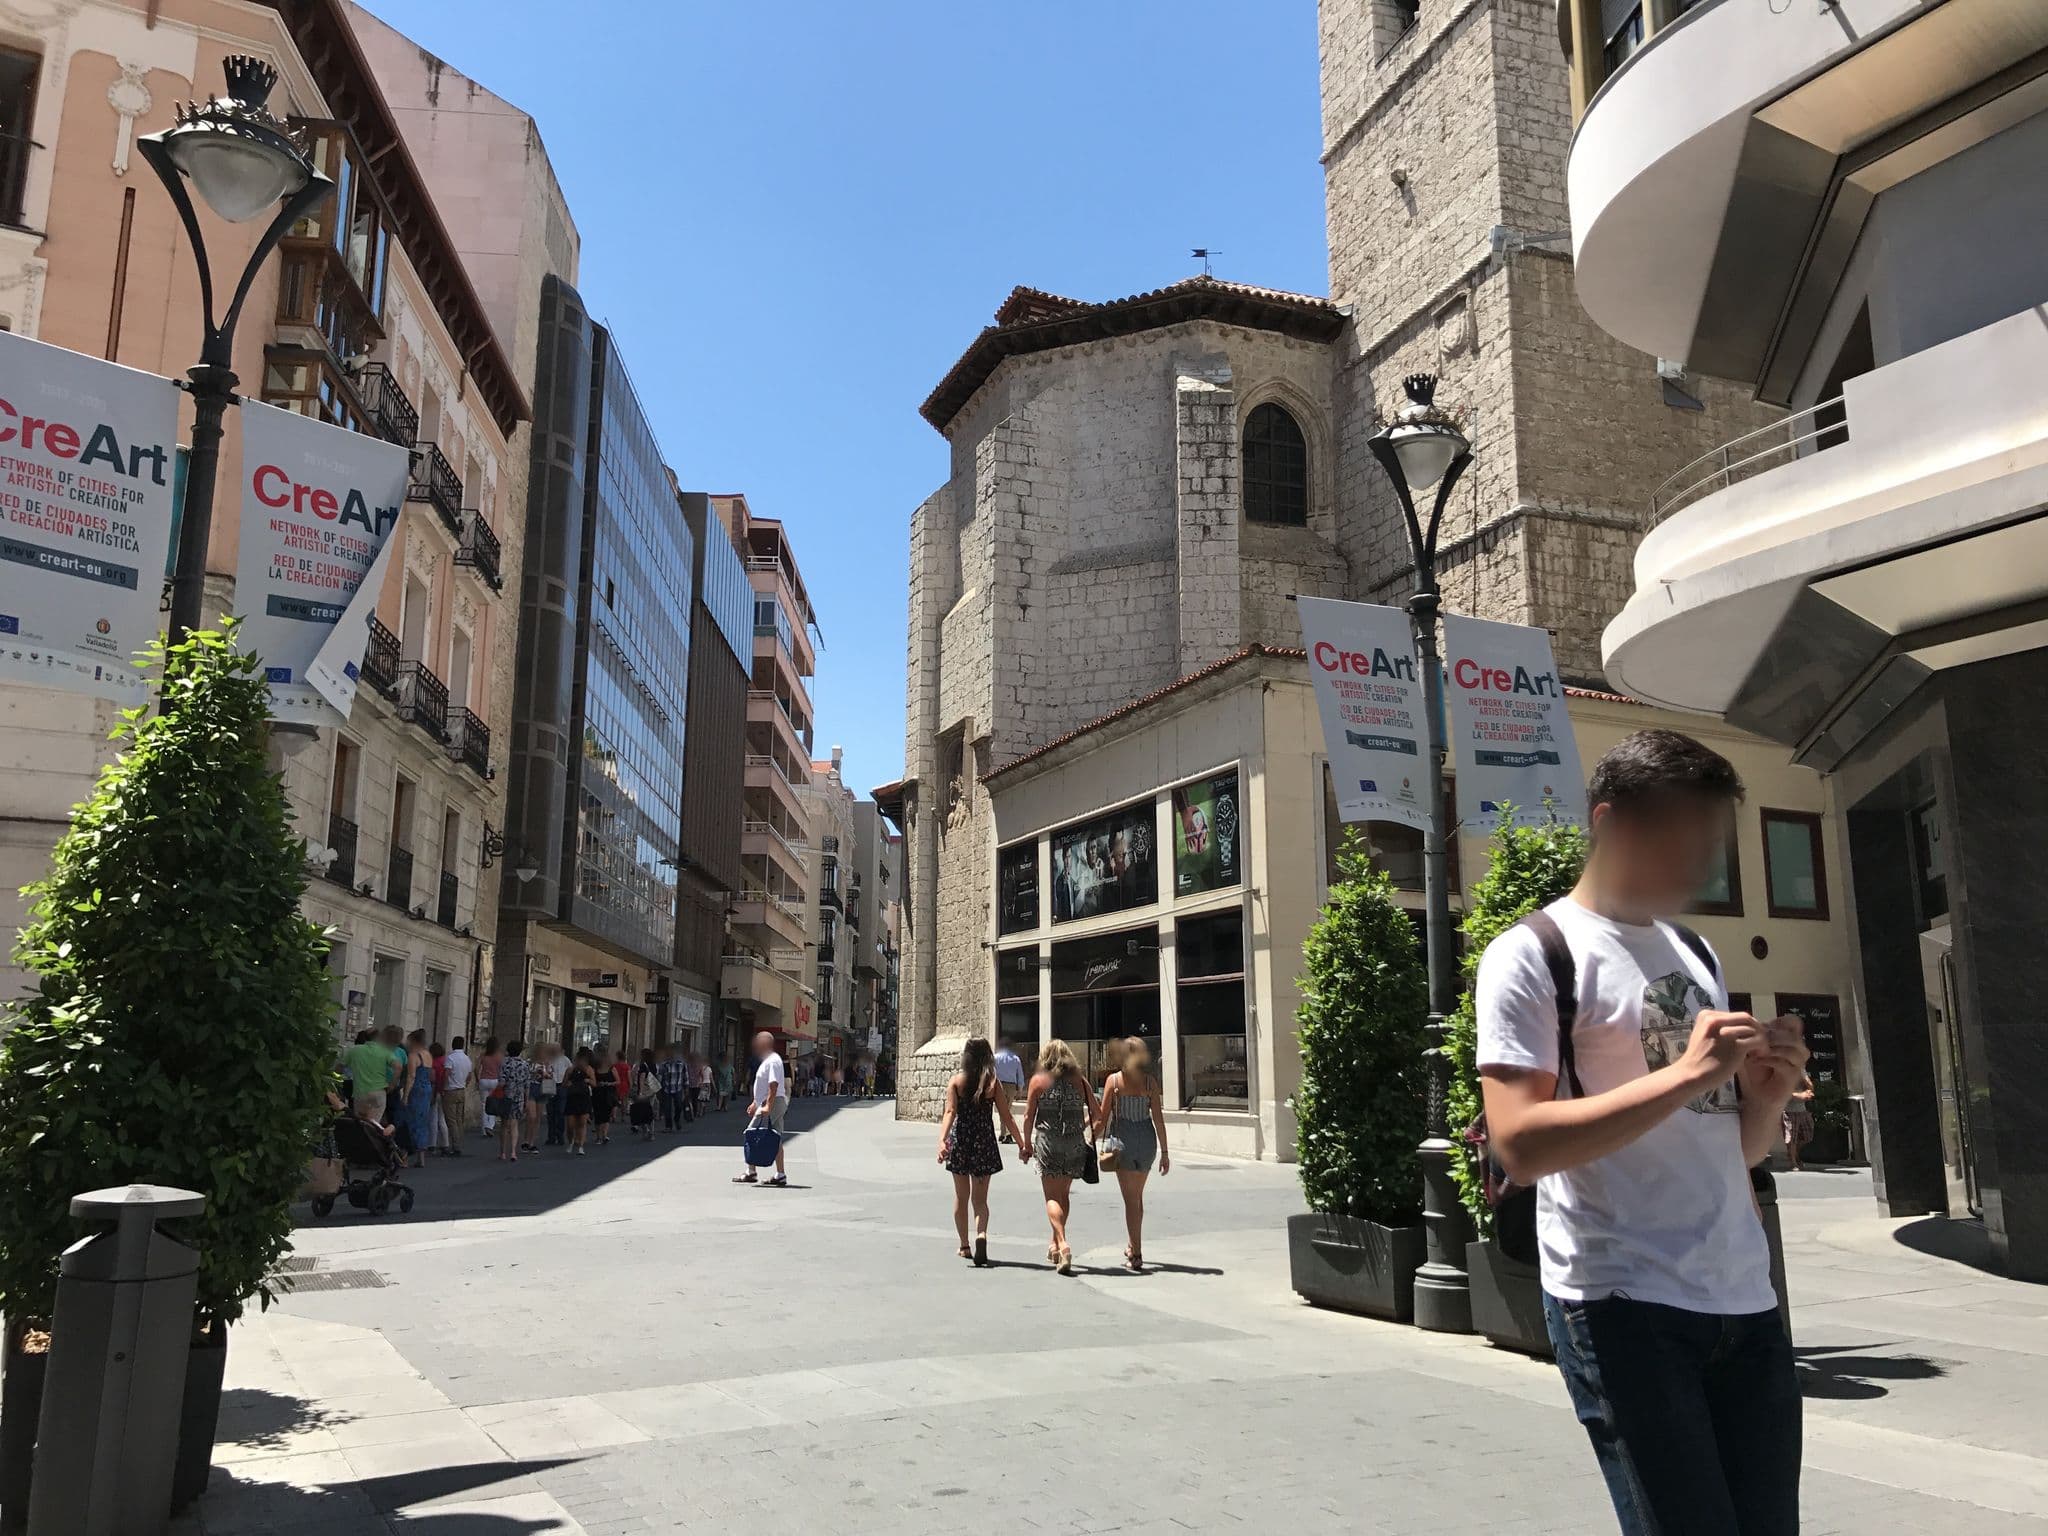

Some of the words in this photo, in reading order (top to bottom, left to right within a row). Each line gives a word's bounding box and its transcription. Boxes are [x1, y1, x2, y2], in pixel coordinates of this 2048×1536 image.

[0, 456, 53, 480] ETWORK
[58, 471, 74, 485] OF
[79, 476, 117, 496] CITIES
[122, 488, 144, 504] FOR
[8, 472, 65, 496] ARTISTIC
[69, 488, 128, 514] CREATION
[26, 500, 41, 514] DE
[46, 503, 107, 530] CIUDADES
[112, 521, 136, 538] POR
[270, 519, 320, 541] NETWORK
[324, 531, 337, 544] OF
[340, 535, 368, 554] CITIES
[284, 535, 330, 555] ARTISTIC
[274, 554, 295, 569] RED
[299, 559, 312, 572] DE
[269, 566, 282, 580] LA
[1314, 641, 1416, 682] CreArt
[1454, 658, 1558, 698] CreArt
[1353, 705, 1362, 714] DE
[1468, 697, 1502, 708] NETWORK
[1504, 699, 1513, 708] OF
[1479, 708, 1511, 717] ARTISTIC
[1511, 709, 1544, 720] CREATION
[1472, 731, 1482, 740] LA
[1474, 721, 1489, 731] RED
[1490, 723, 1501, 731] DE
